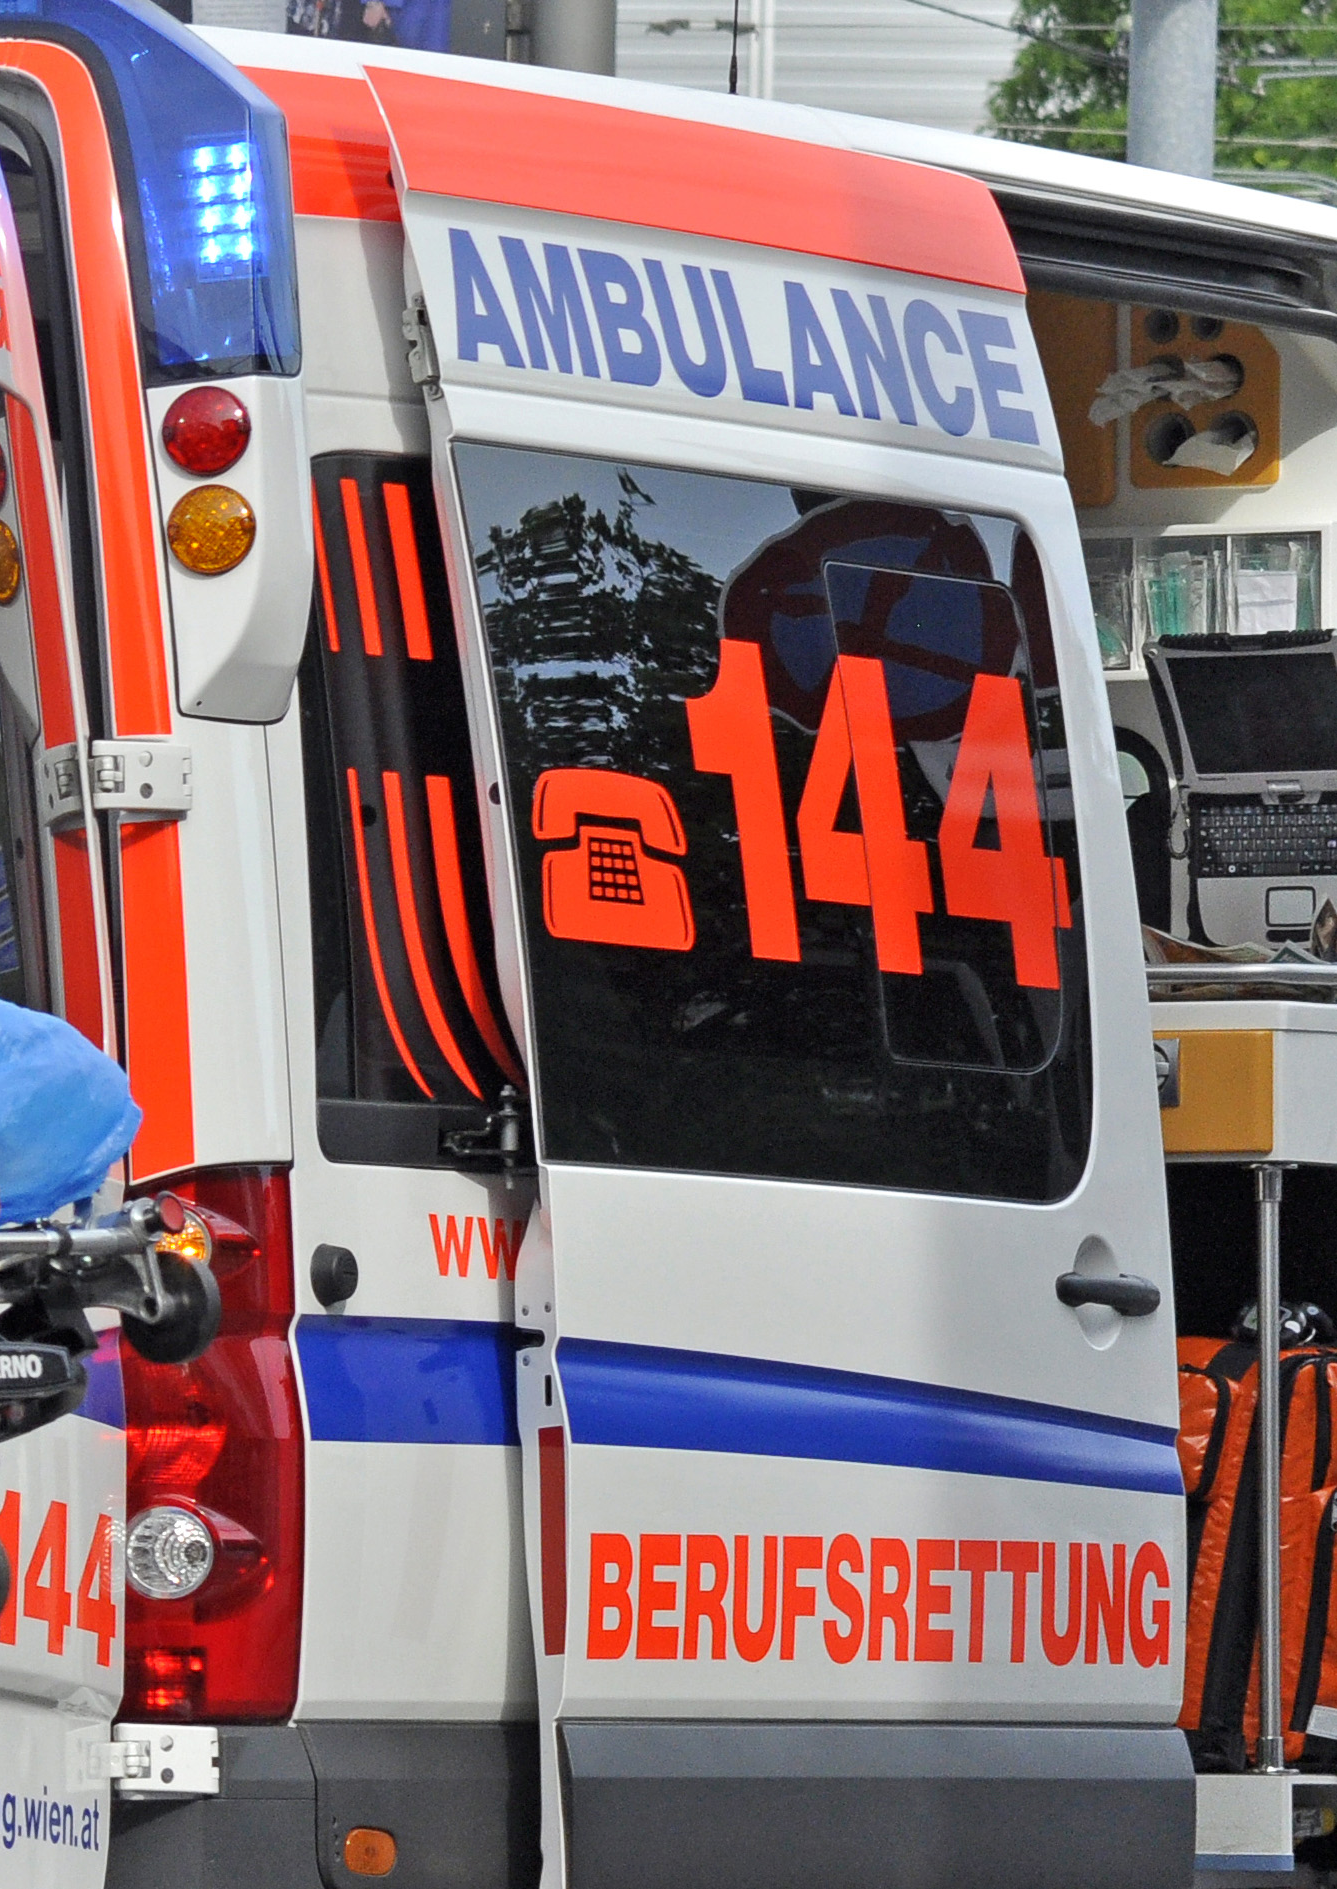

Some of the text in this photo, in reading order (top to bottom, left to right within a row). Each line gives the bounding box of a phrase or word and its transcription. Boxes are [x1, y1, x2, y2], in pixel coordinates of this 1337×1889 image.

[448, 227, 1040, 446] AMBULANCE
[685, 638, 1072, 990] 144
[586, 1532, 1171, 1669] BERUFSRETTUNG
